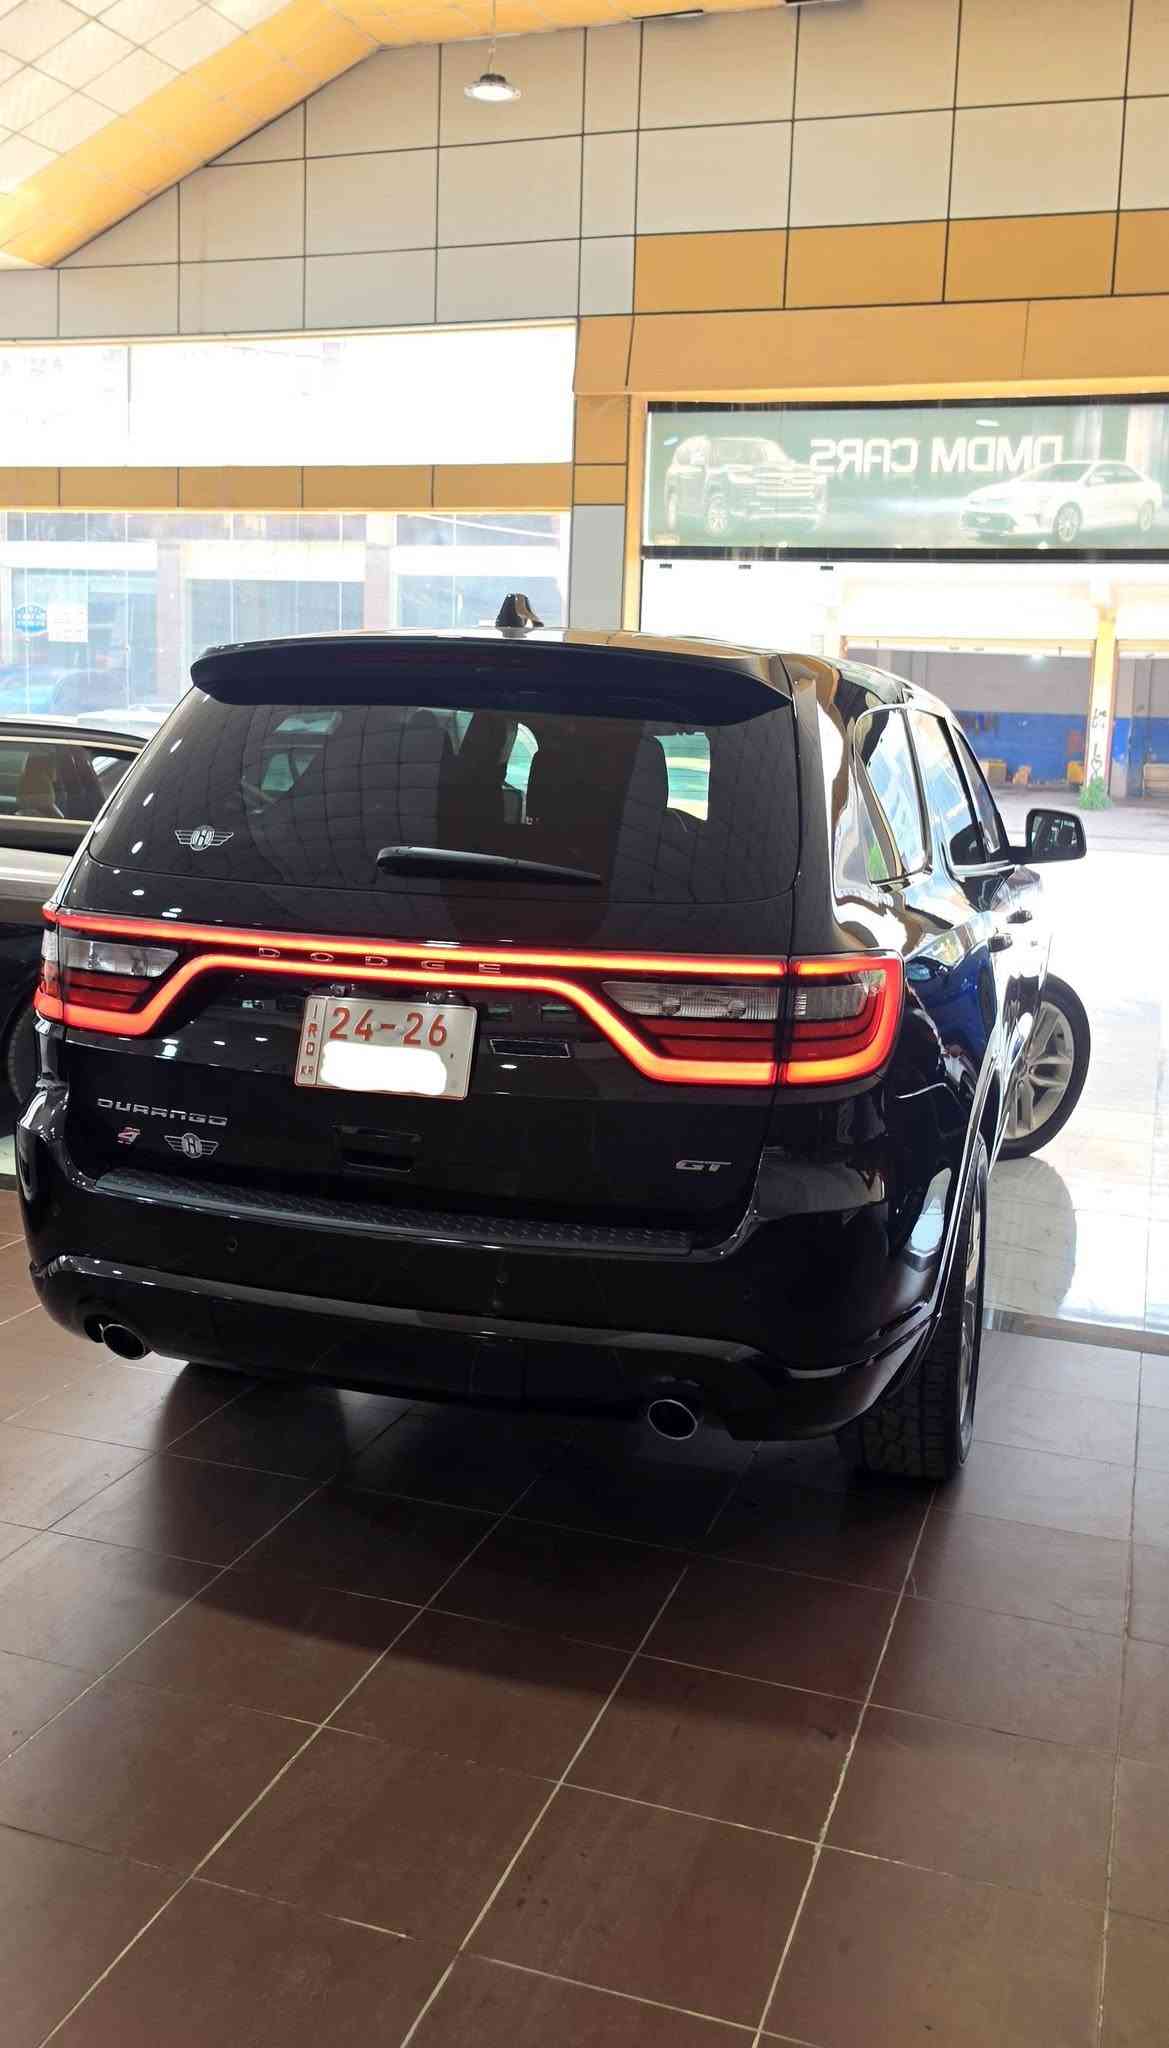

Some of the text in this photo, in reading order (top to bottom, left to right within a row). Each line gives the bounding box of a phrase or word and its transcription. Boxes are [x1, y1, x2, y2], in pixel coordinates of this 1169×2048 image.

[258, 947, 501, 973] DODGE
[328, 1006, 449, 1048] 24-26
[97, 1098, 229, 1127] DURANGO
[675, 1159, 733, 1173] GT
